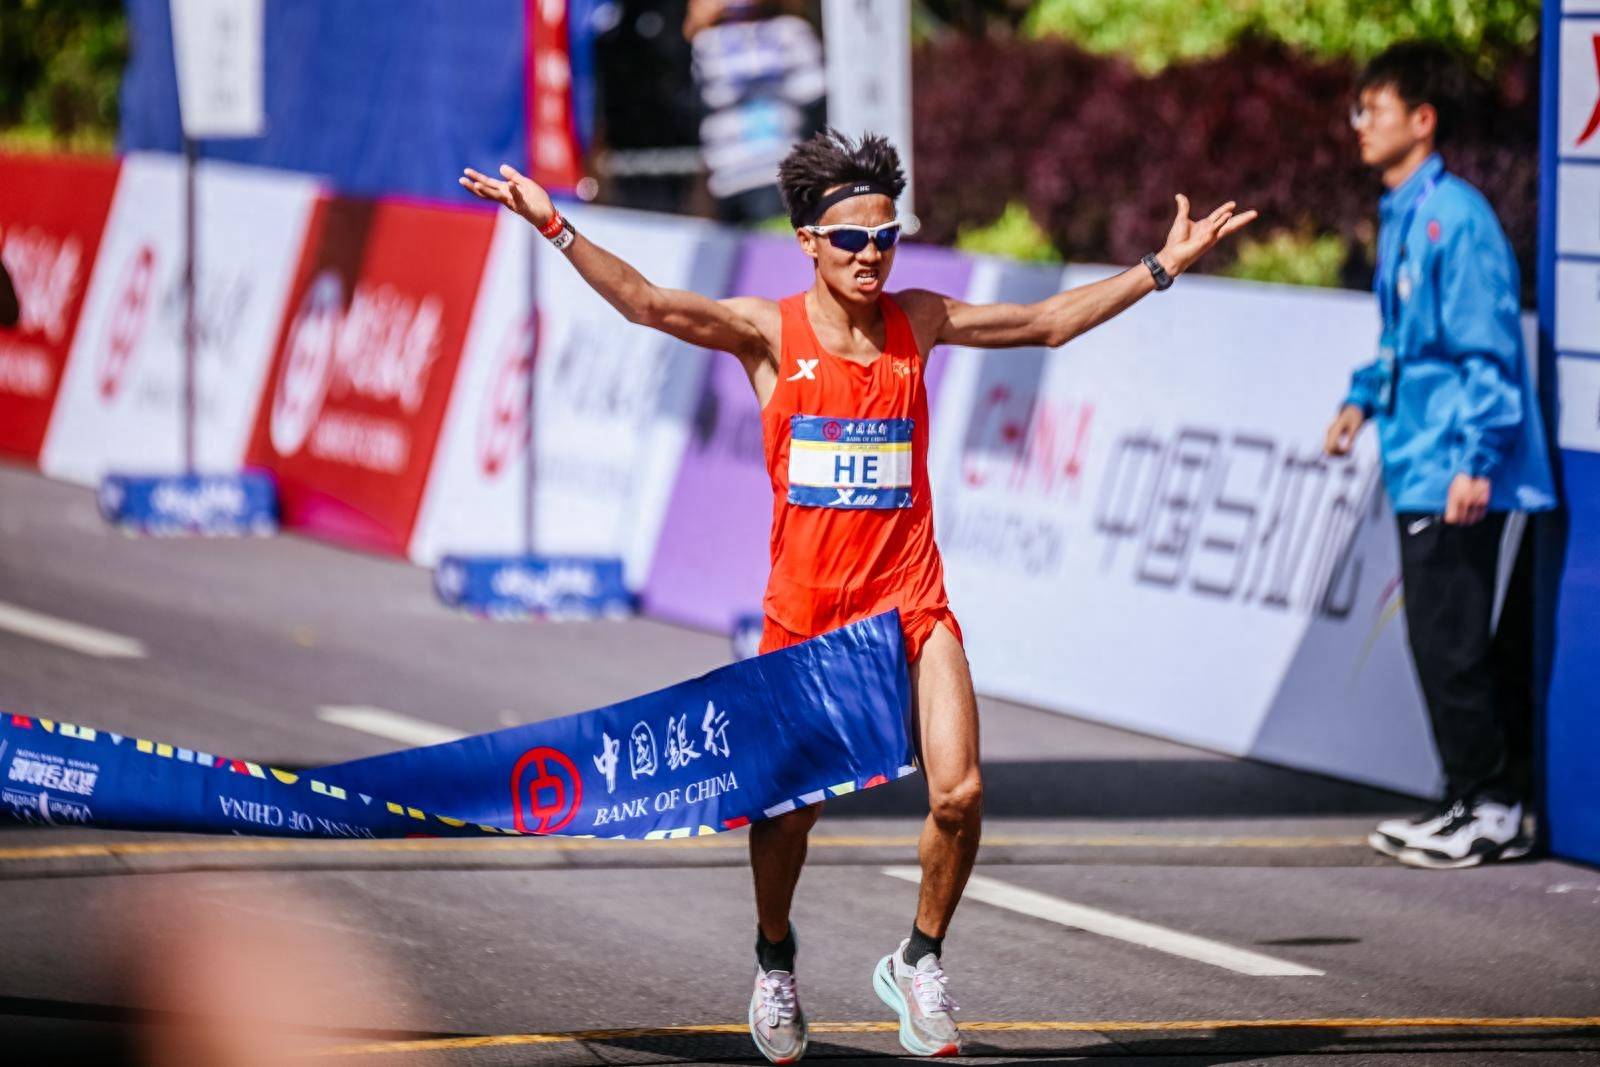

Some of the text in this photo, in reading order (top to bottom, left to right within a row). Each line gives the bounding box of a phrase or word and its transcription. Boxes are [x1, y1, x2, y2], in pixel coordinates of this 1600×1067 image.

[834, 455, 878, 483] HE
[217, 794, 285, 828] CHINA
[592, 770, 738, 826] BANK OF CHINA
[287, 811, 315, 832] OF
